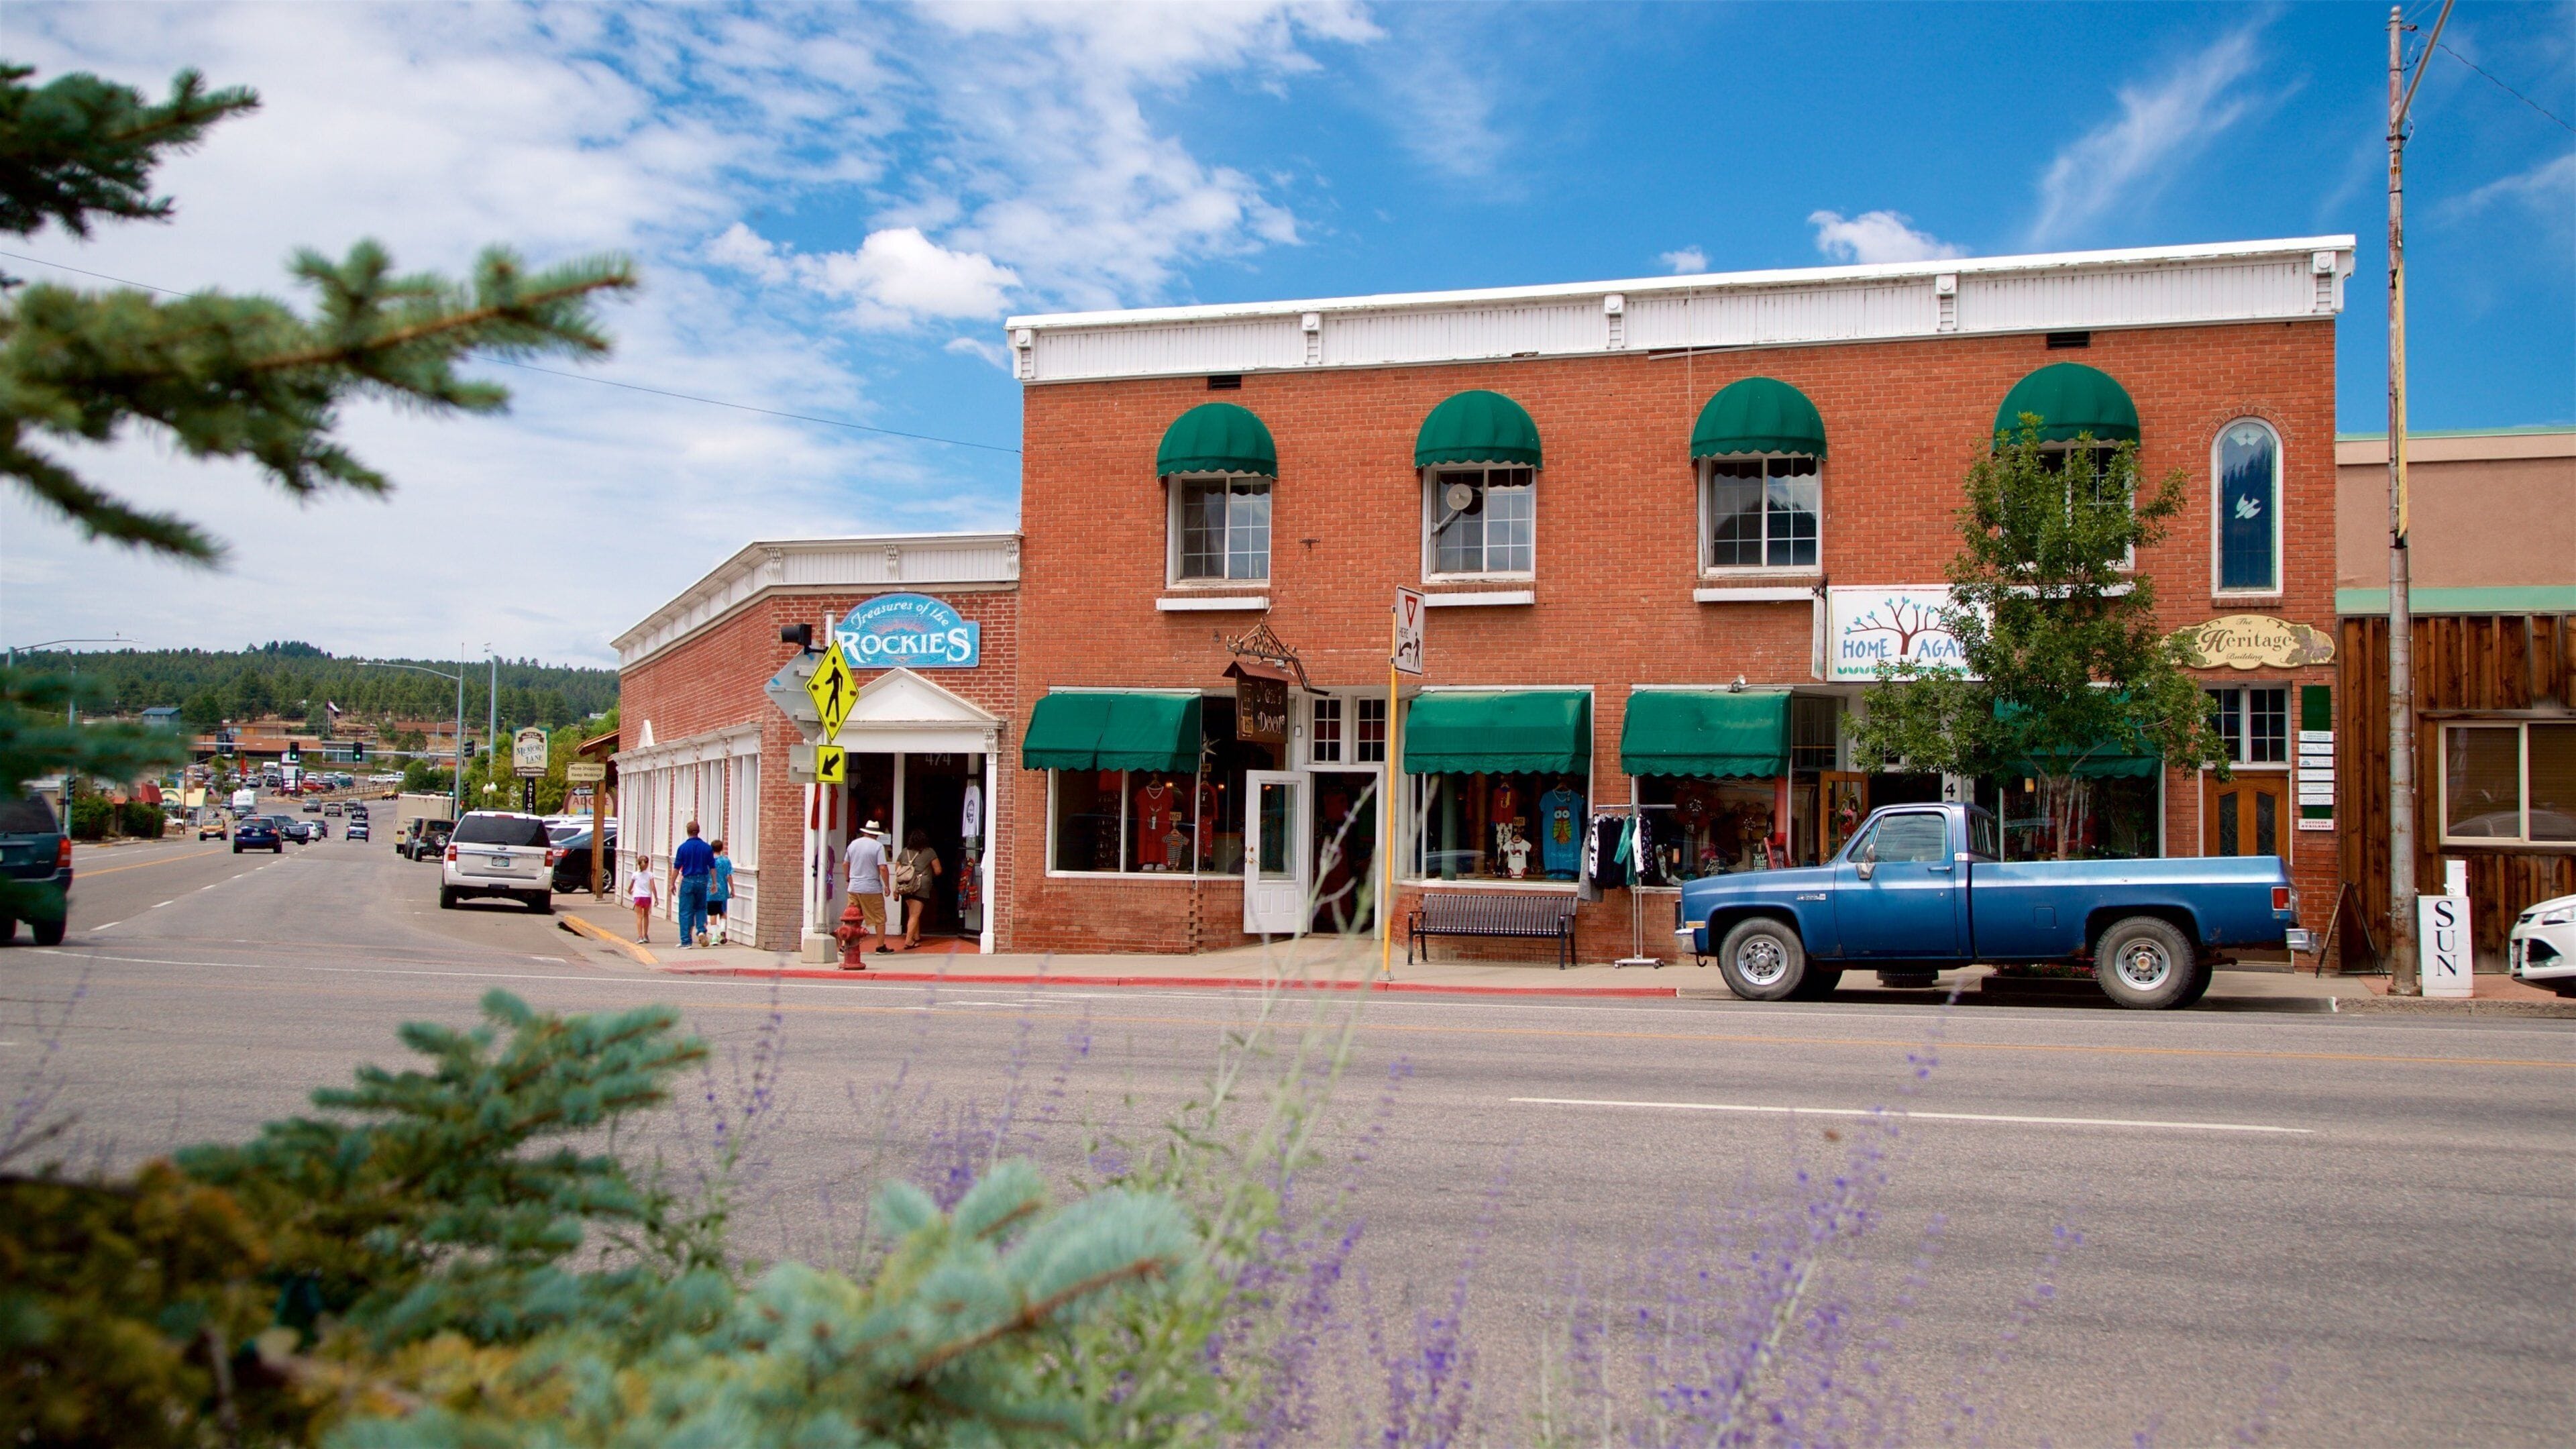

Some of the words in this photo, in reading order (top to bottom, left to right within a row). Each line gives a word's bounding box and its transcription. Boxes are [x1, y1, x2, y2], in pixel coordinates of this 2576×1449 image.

[851, 601, 913, 629] Treasures
[916, 601, 933, 616] of
[930, 609, 949, 627] the
[2236, 617, 2253, 625] The
[1399, 627, 1409, 639] HERE
[835, 628, 971, 663] ROCKIES
[2198, 629, 2292, 653] Heritage
[1843, 638, 1892, 659] HOME
[1917, 639, 1964, 658] AGAI
[2226, 653, 2264, 661] Building
[1258, 711, 1285, 734] Door
[517, 745, 545, 757] MEMORY
[526, 755, 543, 765] LANE
[925, 753, 951, 765] 474
[573, 796, 610, 806] ADOE
[2434, 900, 2457, 977] SUN
